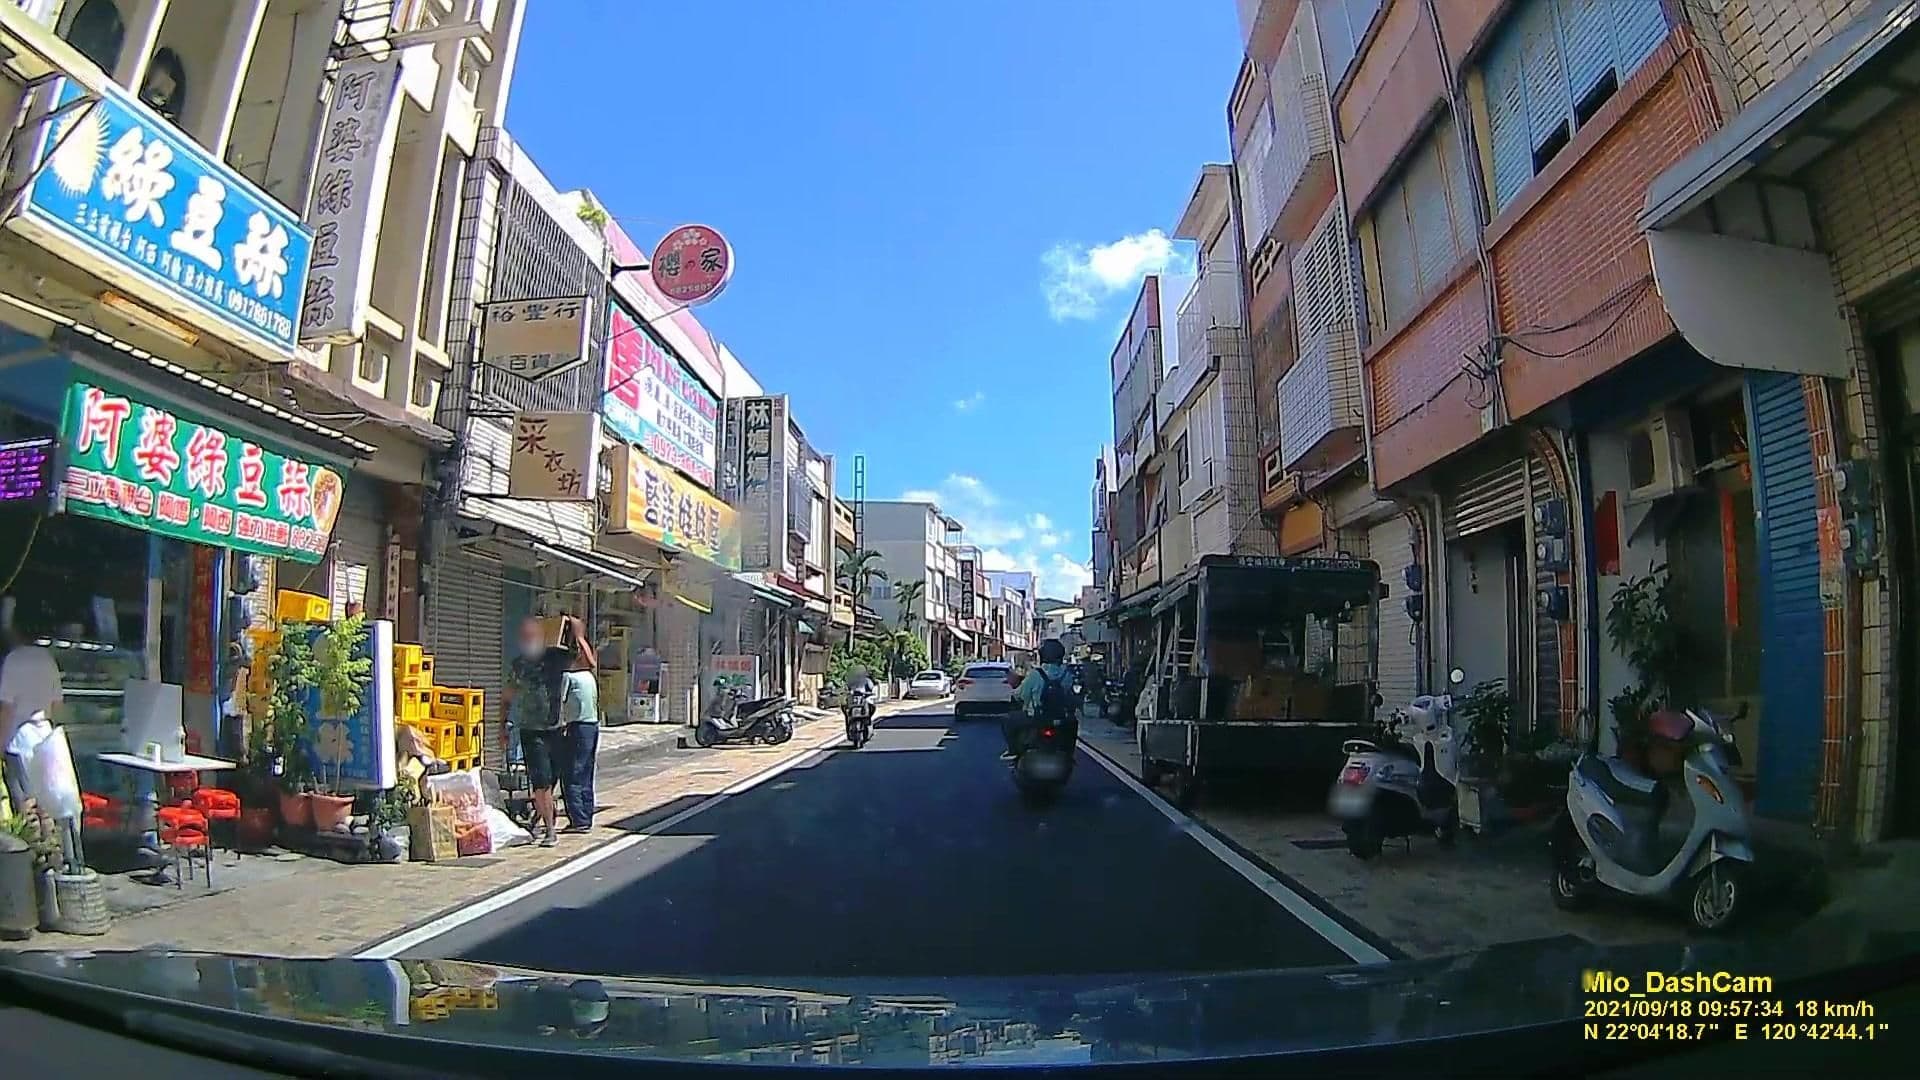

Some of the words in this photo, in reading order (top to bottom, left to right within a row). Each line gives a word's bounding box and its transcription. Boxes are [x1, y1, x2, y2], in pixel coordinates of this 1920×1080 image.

[102, 126, 289, 299] 綠豆蒜
[79, 387, 312, 520] 阿婆綠豆蒜
